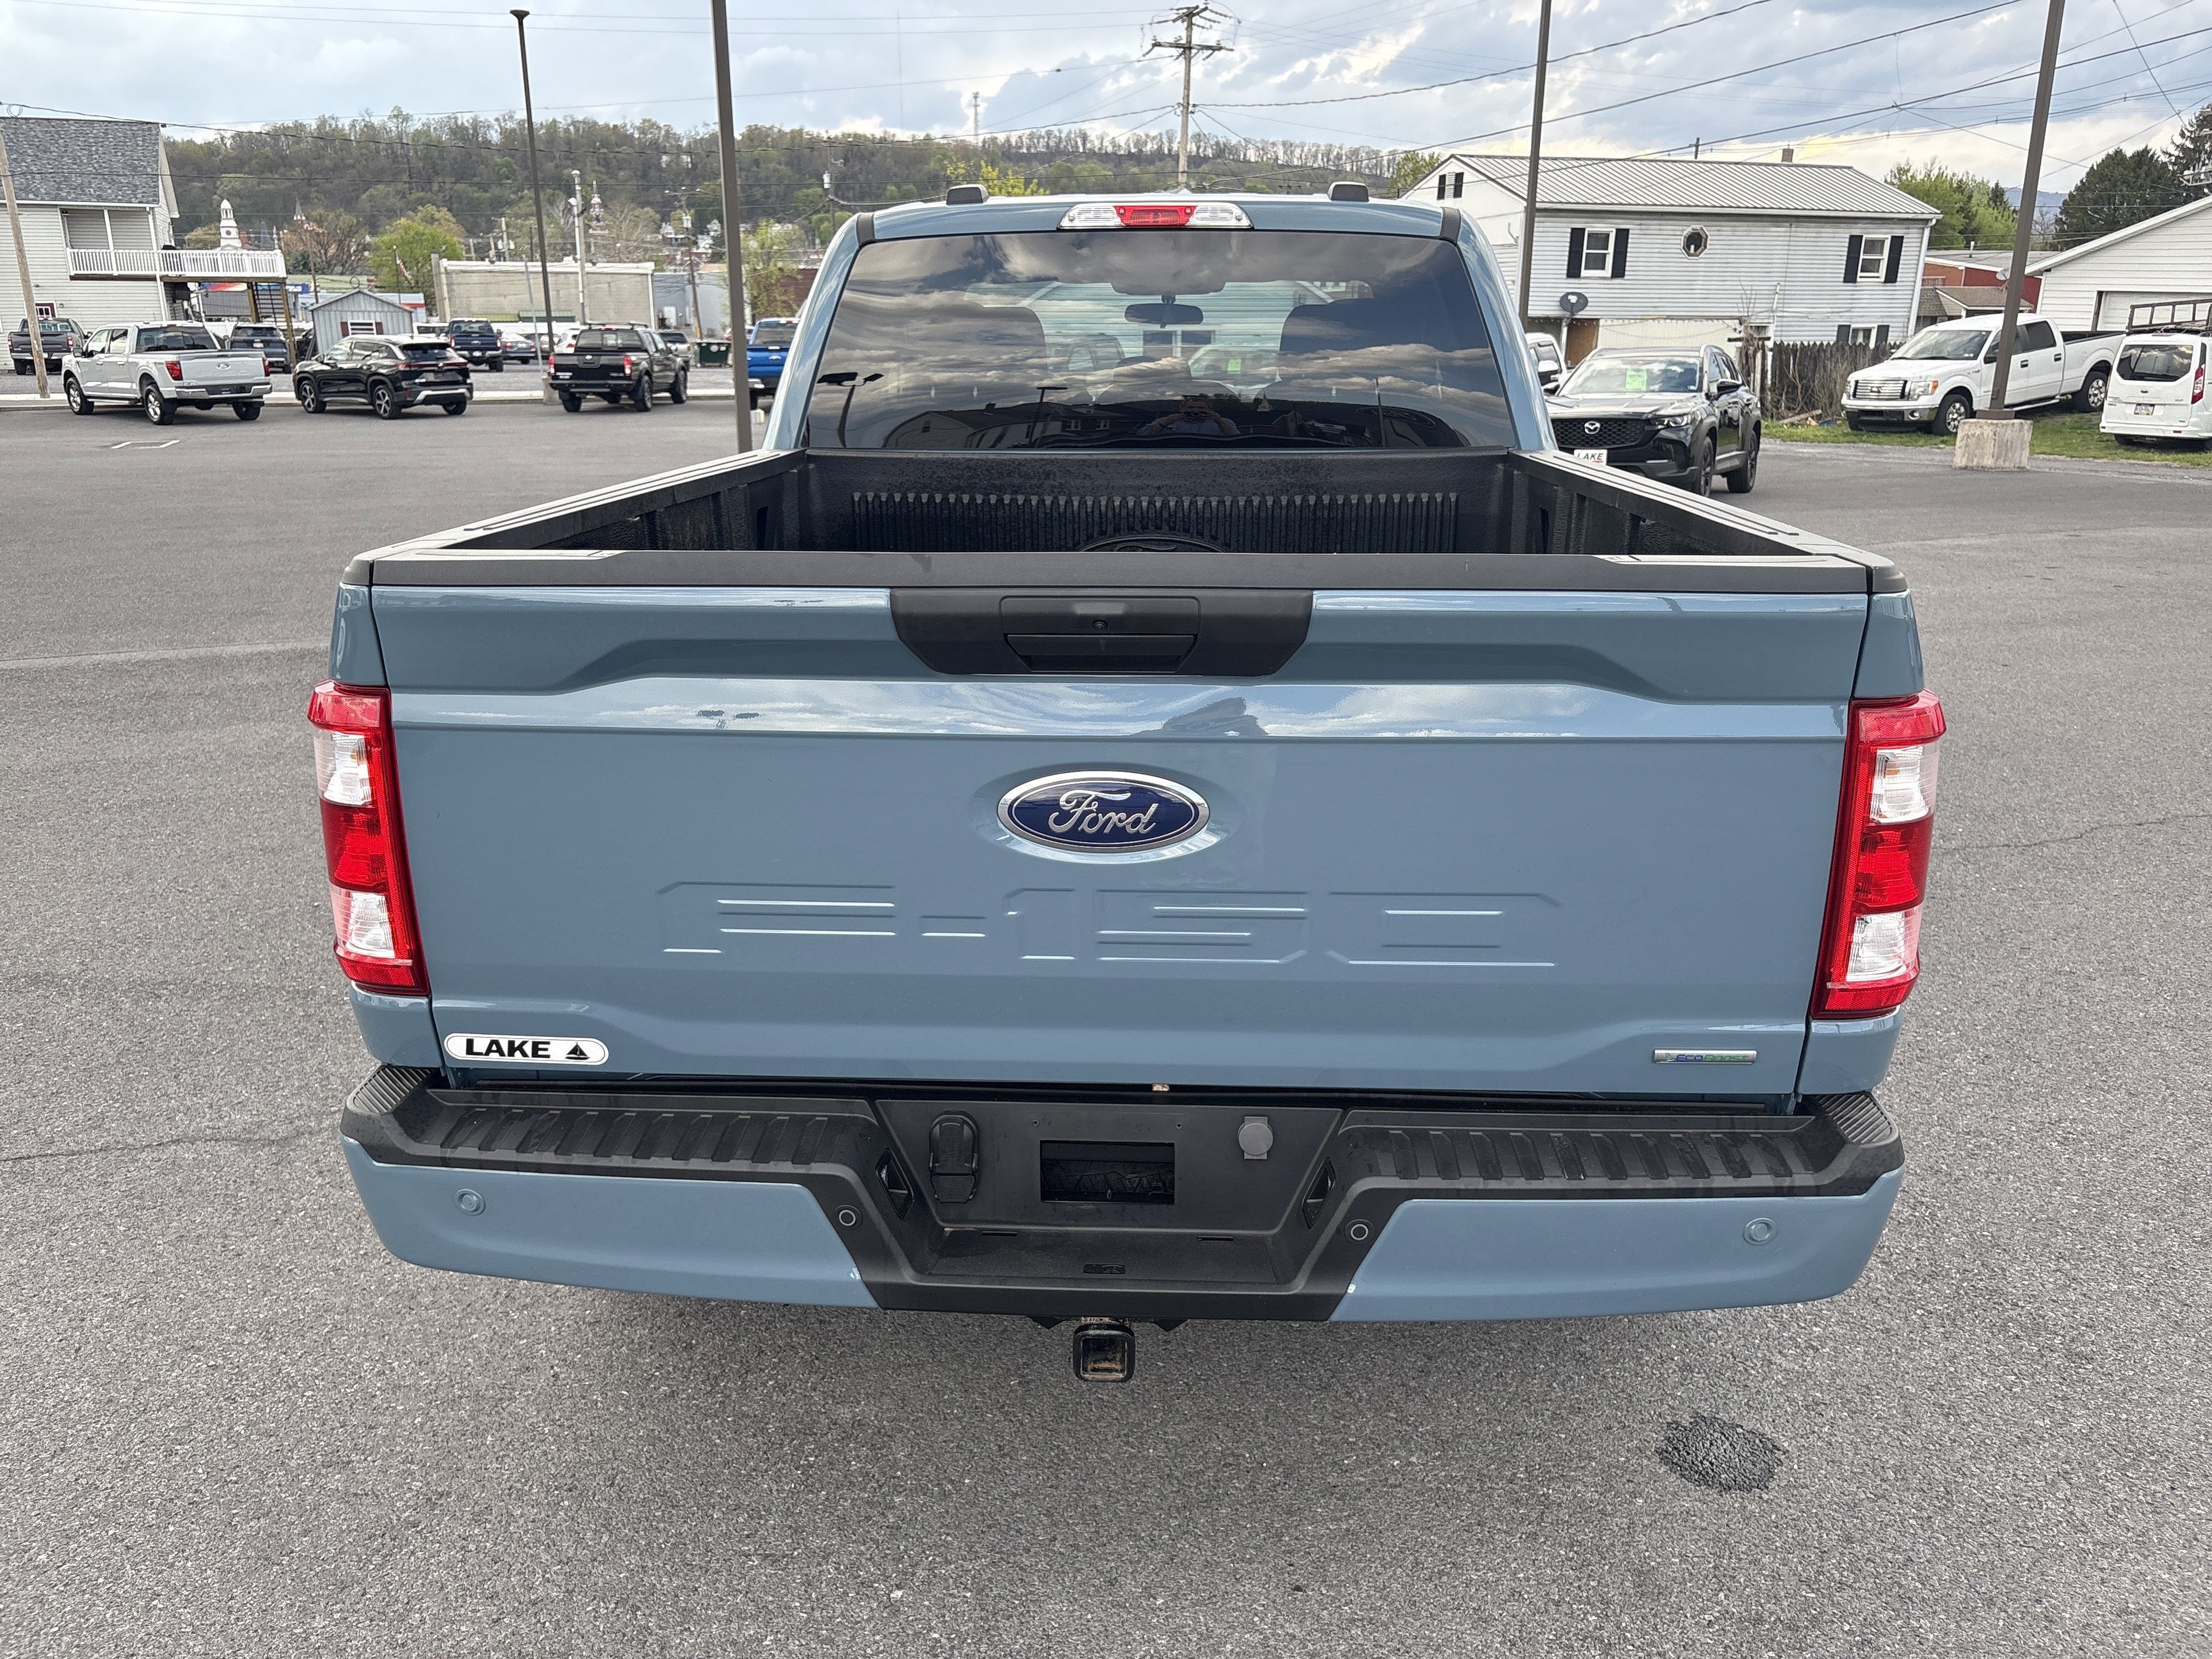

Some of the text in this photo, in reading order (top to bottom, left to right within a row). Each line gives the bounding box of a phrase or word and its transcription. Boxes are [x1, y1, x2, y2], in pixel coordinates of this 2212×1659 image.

[1048, 789, 1159, 834] Ford
[656, 881, 1562, 966] F-150
[465, 1038, 551, 1058] LAKE
